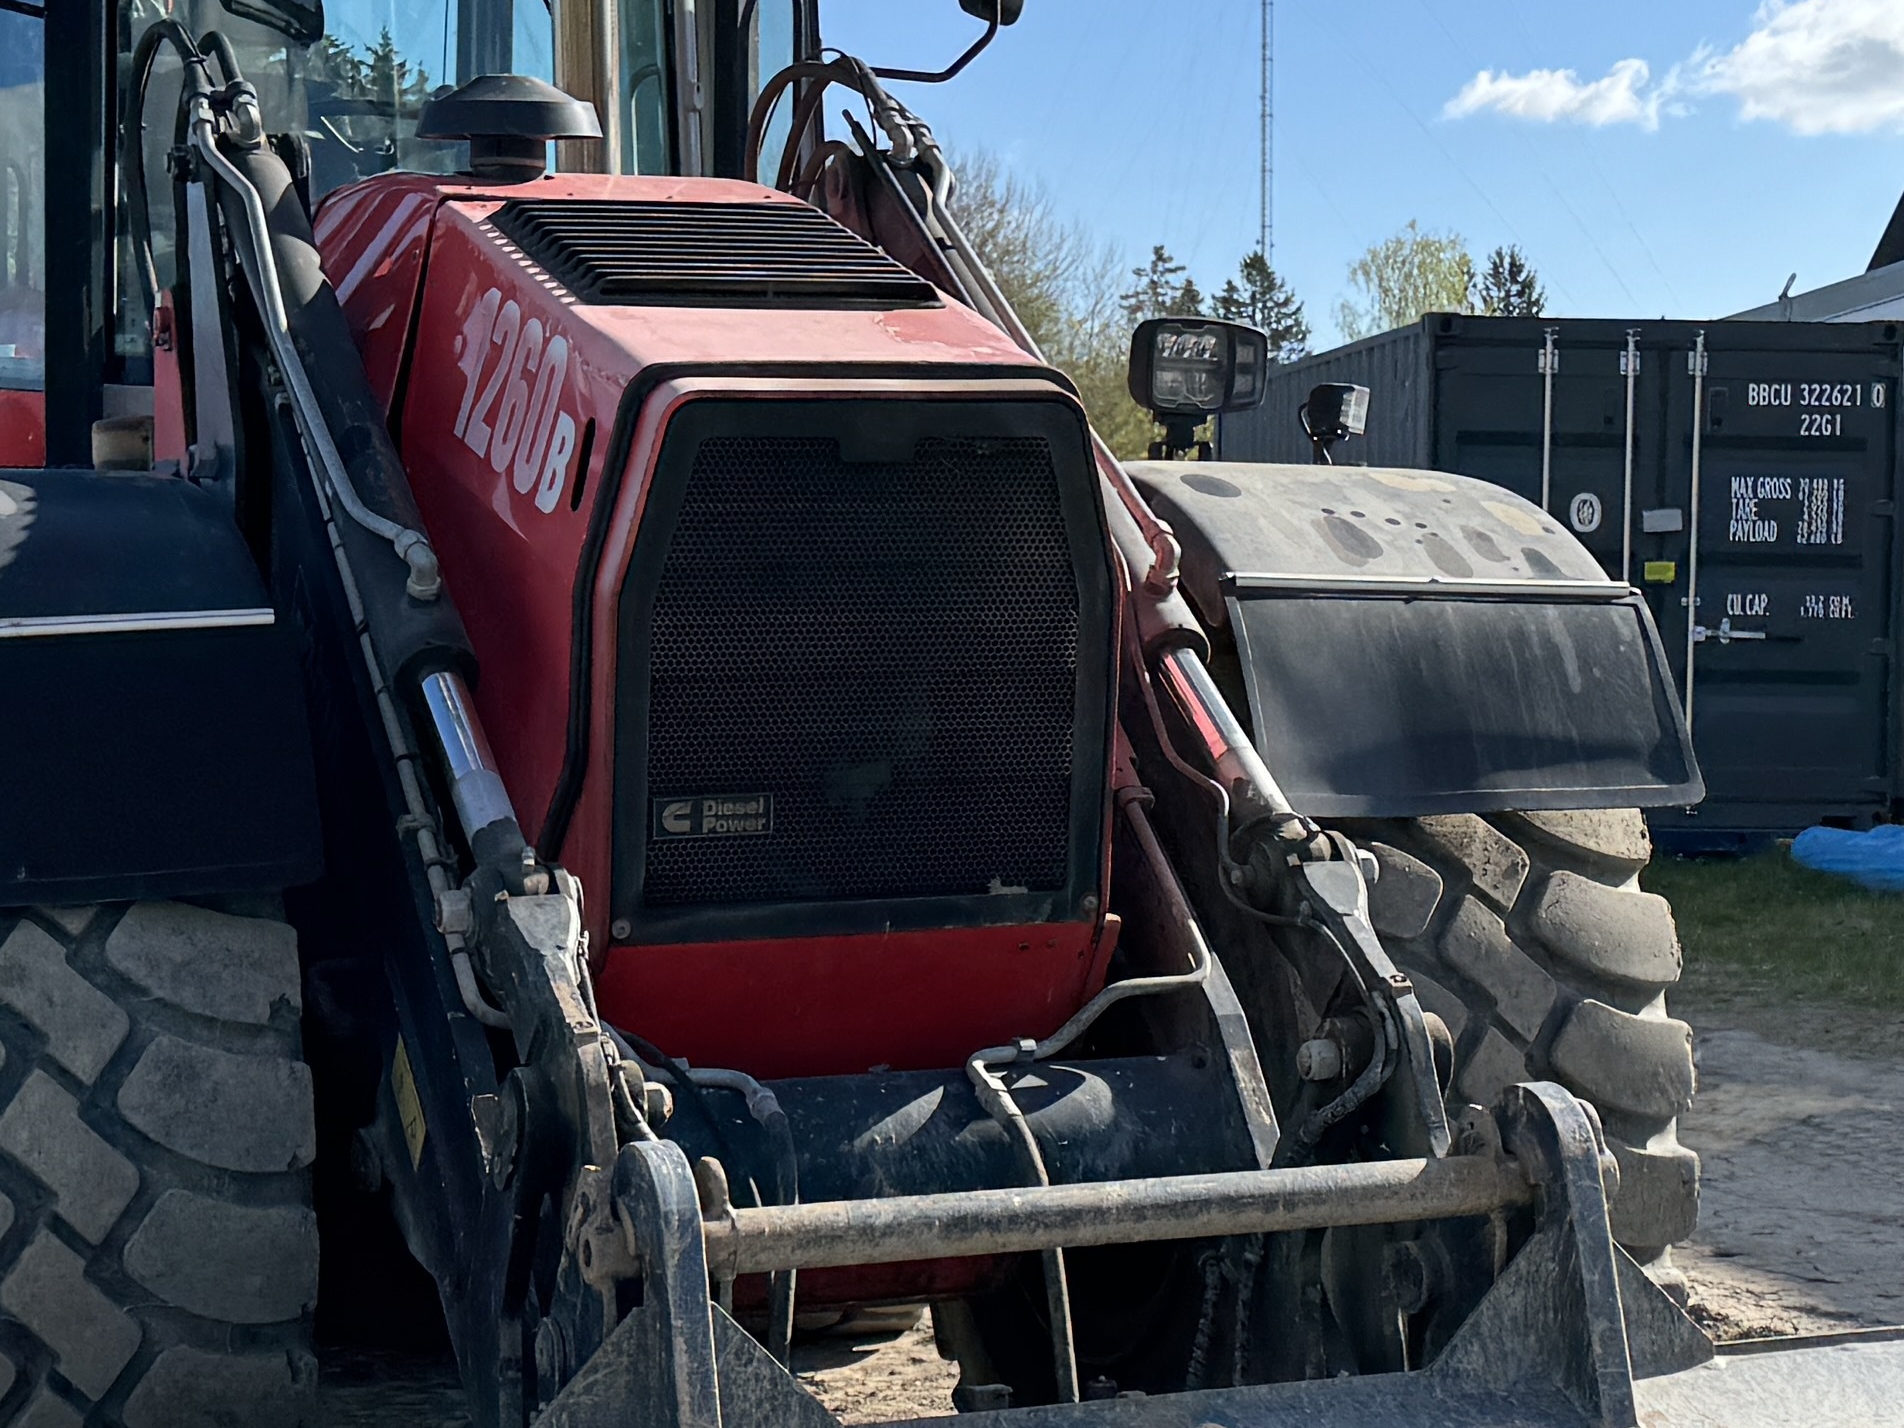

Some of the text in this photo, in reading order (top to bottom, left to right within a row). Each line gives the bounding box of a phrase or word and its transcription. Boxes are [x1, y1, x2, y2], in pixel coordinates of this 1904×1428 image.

[453, 287, 575, 514] 1260B
[1748, 383, 1791, 406] BBCU
[1800, 383, 1862, 406] 322621
[1800, 414, 1841, 436] 22G1
[1757, 476, 1792, 500] GROSS
[1729, 520, 1778, 542] PAYLOAD
[702, 796, 764, 816] Diesel
[702, 816, 767, 834] Power
